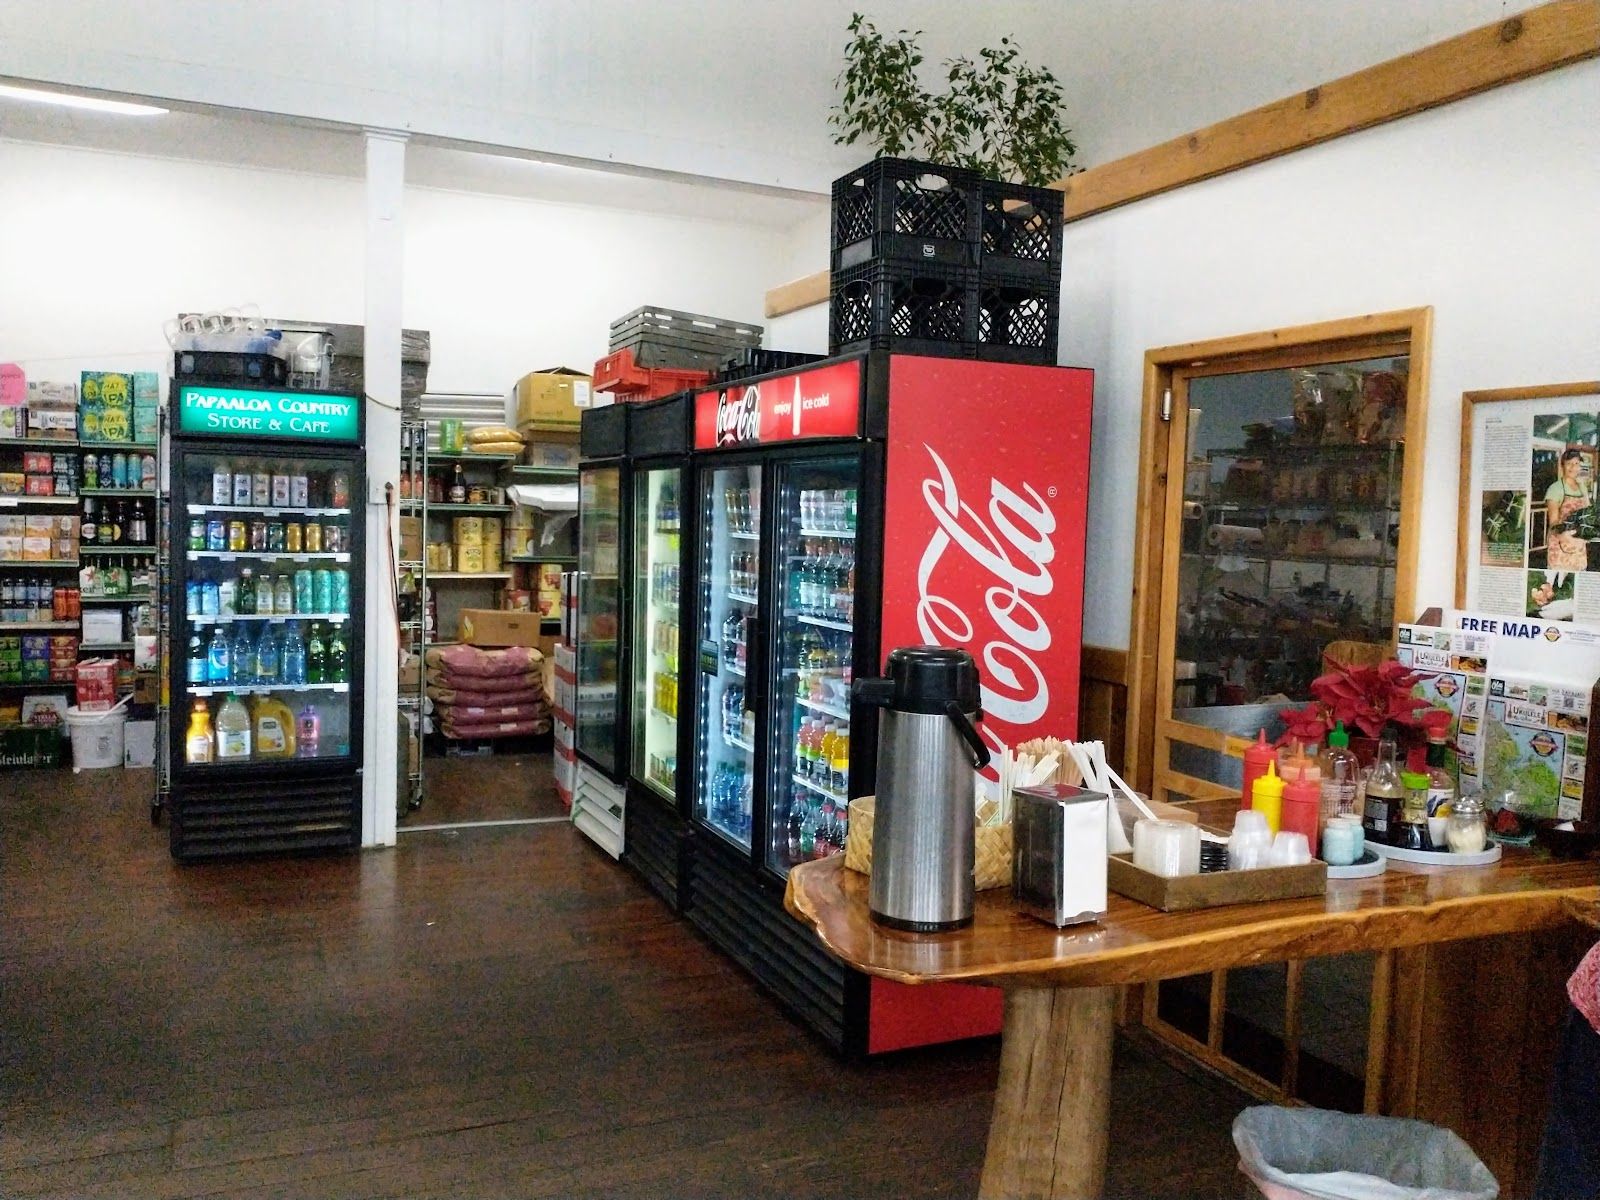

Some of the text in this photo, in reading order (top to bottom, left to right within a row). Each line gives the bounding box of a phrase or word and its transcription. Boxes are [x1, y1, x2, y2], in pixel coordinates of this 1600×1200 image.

[186, 392, 352, 417] PAPAALOA COUNTRY
[773, 400, 792, 416] enjoy
[802, 392, 830, 410] ice cold
[207, 412, 332, 434] STORE & CAFE
[1461, 616, 1498, 635] FREE
[1502, 620, 1542, 639] MAP
